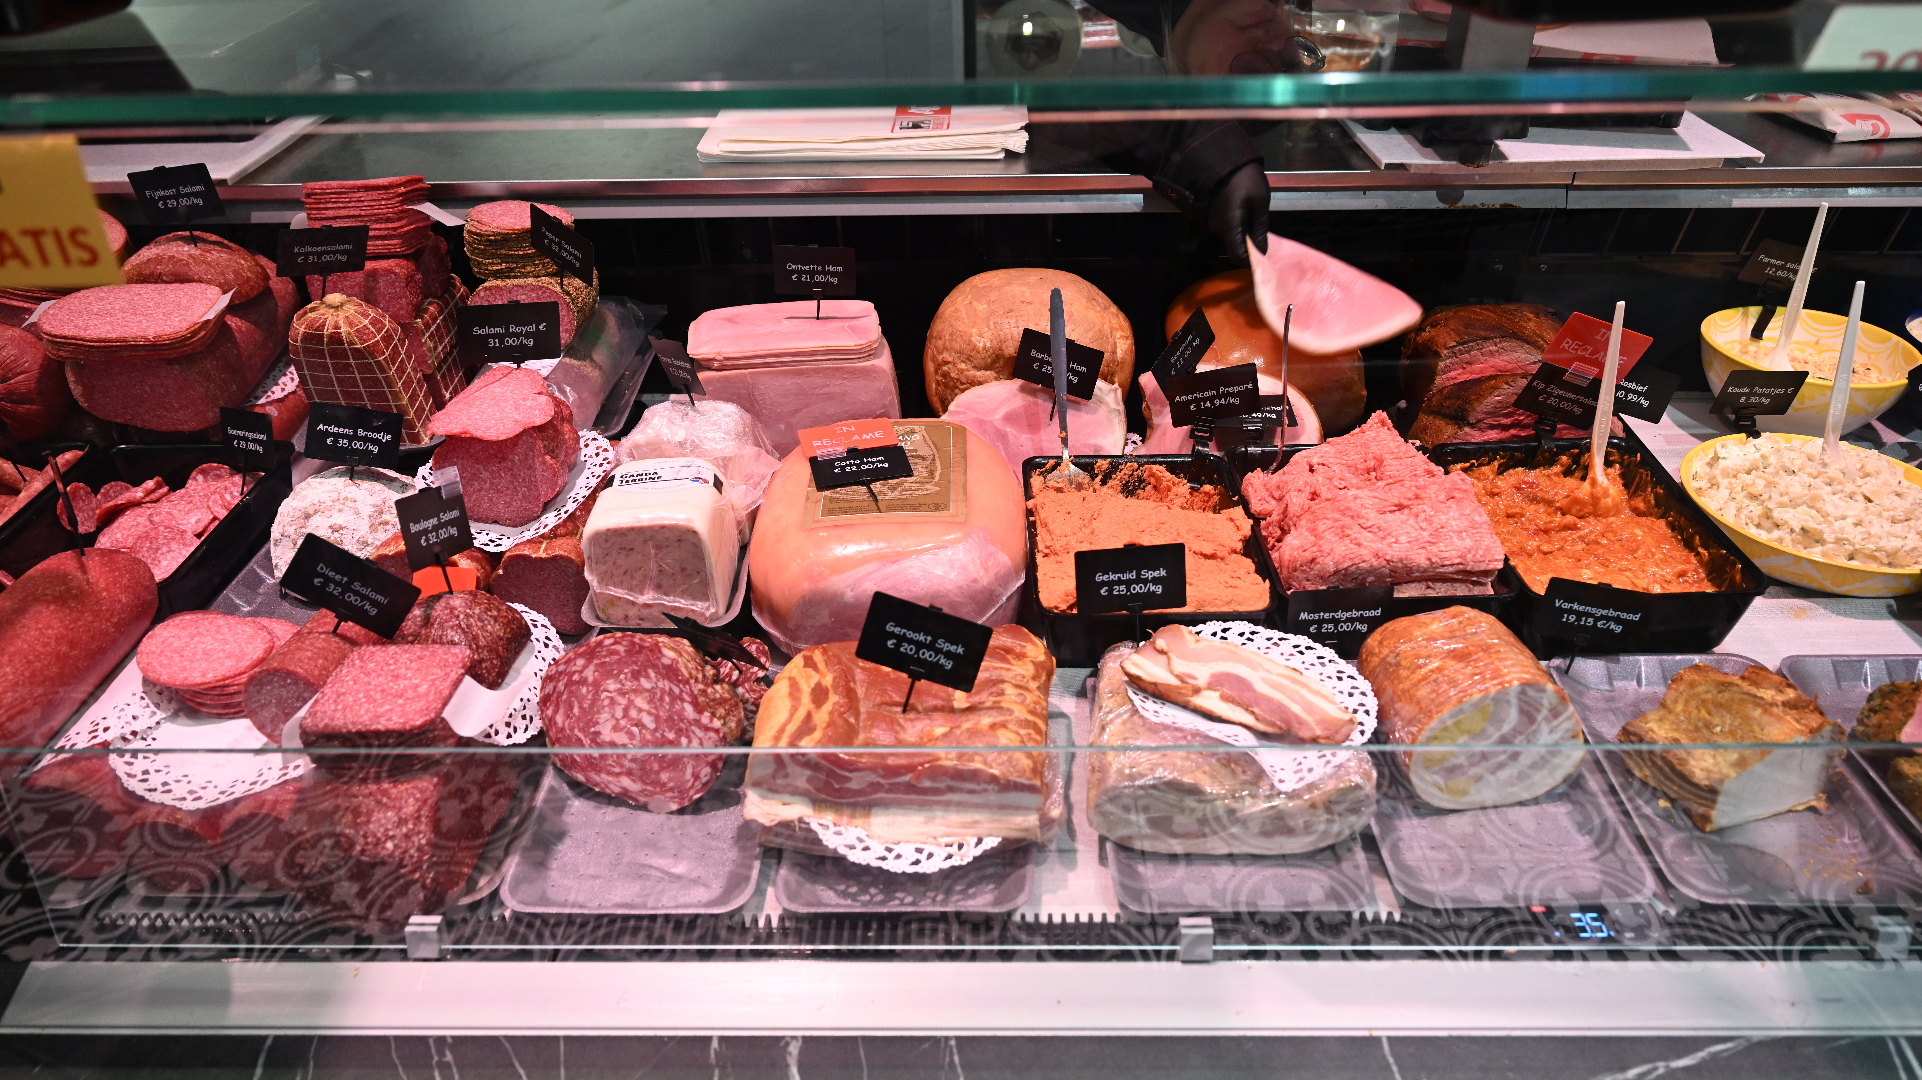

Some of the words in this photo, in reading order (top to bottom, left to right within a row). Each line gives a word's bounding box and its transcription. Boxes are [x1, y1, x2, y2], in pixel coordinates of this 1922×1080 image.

[179, 184, 205, 194] Salami
[158, 201, 165, 209] €
[167, 197, 203, 207] 29,00/kg
[294, 243, 353, 253] Kalkoensalami
[561, 240, 582, 259] Salami
[307, 254, 347, 262] 31,00/kg
[1757, 254, 1785, 266] Farmer
[786, 262, 823, 272] Ontvette
[825, 264, 843, 272] Ham
[801, 274, 838, 285] 21,00/kg
[473, 325, 505, 335] Salami
[509, 323, 536, 335] Royal
[538, 322, 547, 331] €
[488, 336, 534, 348] 31,00/kg
[1560, 338, 1628, 369] RECLAE
[1033, 362, 1040, 370] €
[1069, 361, 1087, 373] Ham
[1531, 379, 1546, 391] Kip
[1753, 386, 1785, 396] Patatjes
[1174, 390, 1217, 403] Americain
[1219, 381, 1254, 394] Preparé
[1200, 397, 1240, 410] 14,94/kg
[1547, 396, 1583, 415] 20,00/kg
[316, 423, 354, 436] Ardeens
[357, 428, 392, 443] Broodje
[834, 425, 856, 434] IN
[233, 439, 238, 448] €
[812, 430, 885, 447] RECLAME
[326, 437, 333, 445] €
[336, 438, 379, 454] 35,00/kg
[834, 459, 861, 467] Cotto
[409, 517, 439, 533] Boulogne
[439, 506, 460, 523] Salami
[420, 535, 427, 547] €
[427, 526, 458, 544] 32,00/kg
[1095, 569, 1136, 582] Gekruid
[1140, 567, 1167, 580] Spek
[316, 563, 348, 584] Dieet
[350, 581, 390, 605] Salami
[1099, 586, 1109, 596] €
[1112, 583, 1163, 596] 25,00/kg
[313, 577, 324, 586] €
[325, 582, 378, 617] 32,00/kg
[1298, 607, 1382, 621] Mosterdgebraad
[1554, 598, 1642, 621] Varkensgebraad
[1309, 624, 1318, 633] €
[1321, 621, 1368, 633] 25,00/kg
[1561, 613, 1594, 626] 19,15
[1596, 620, 1623, 634] €/kg
[885, 621, 933, 644] Gerookt
[935, 638, 966, 656] Spek
[886, 639, 898, 649] €
[899, 642, 954, 670] 20,00/kg
